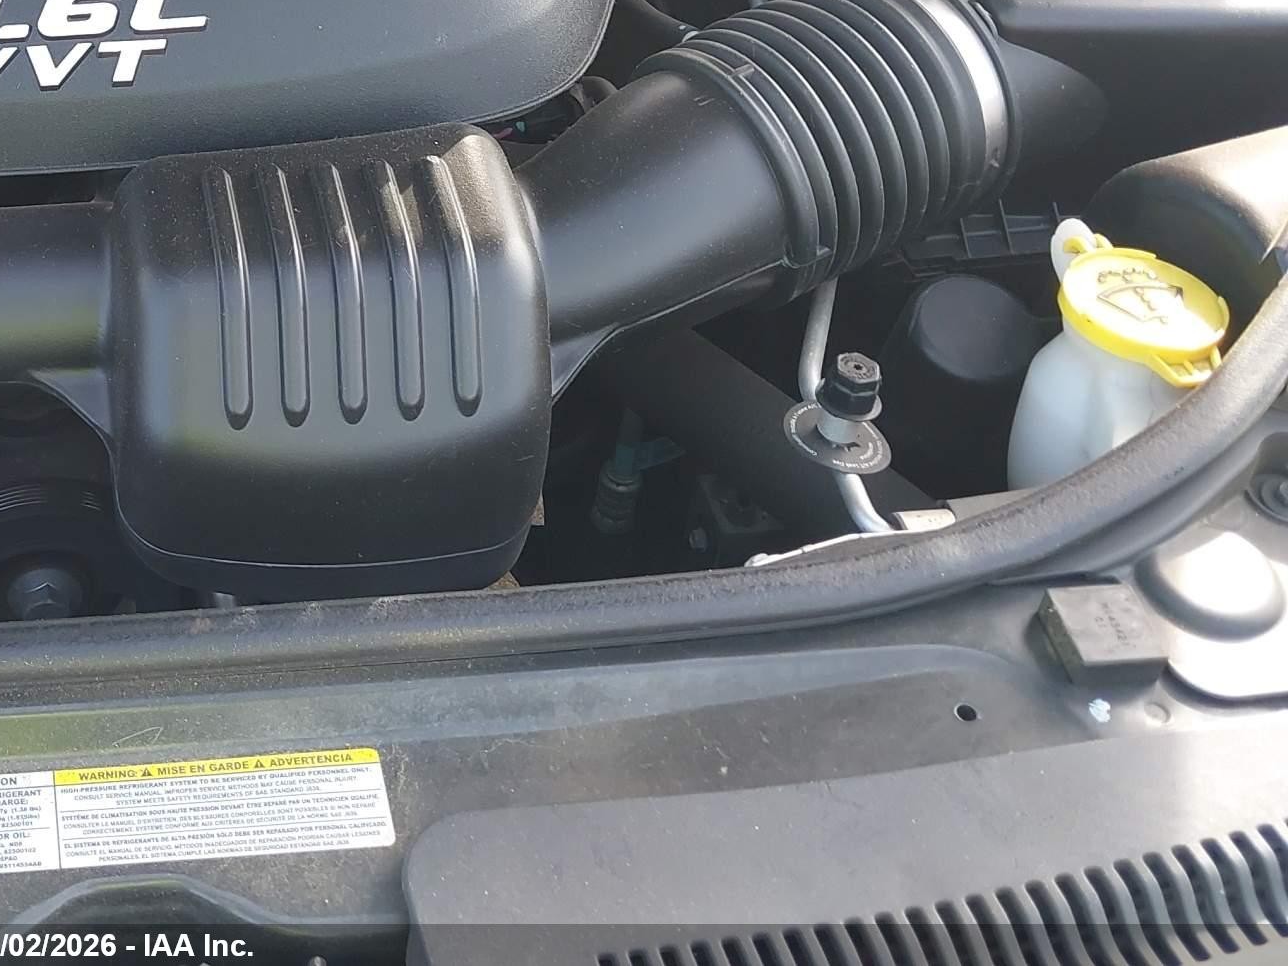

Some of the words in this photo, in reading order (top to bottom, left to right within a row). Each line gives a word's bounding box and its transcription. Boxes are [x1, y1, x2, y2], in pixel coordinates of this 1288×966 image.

[157, 765, 186, 775] MISE
[189, 764, 205, 773] EN
[208, 761, 249, 771] GARDE
[269, 753, 352, 767] ADVERTENCIA
[74, 793, 104, 801] CONSULT
[227, 782, 259, 790] METHODS
[298, 777, 332, 785] PERSONAL
[119, 781, 167, 789] REFRIGERANT
[269, 771, 306, 779] QUALIFIED
[307, 768, 349, 776] PERSONNEL
[193, 791, 243, 800] REQUIREMENTS
[100, 810, 146, 818] CLIMATISATION
